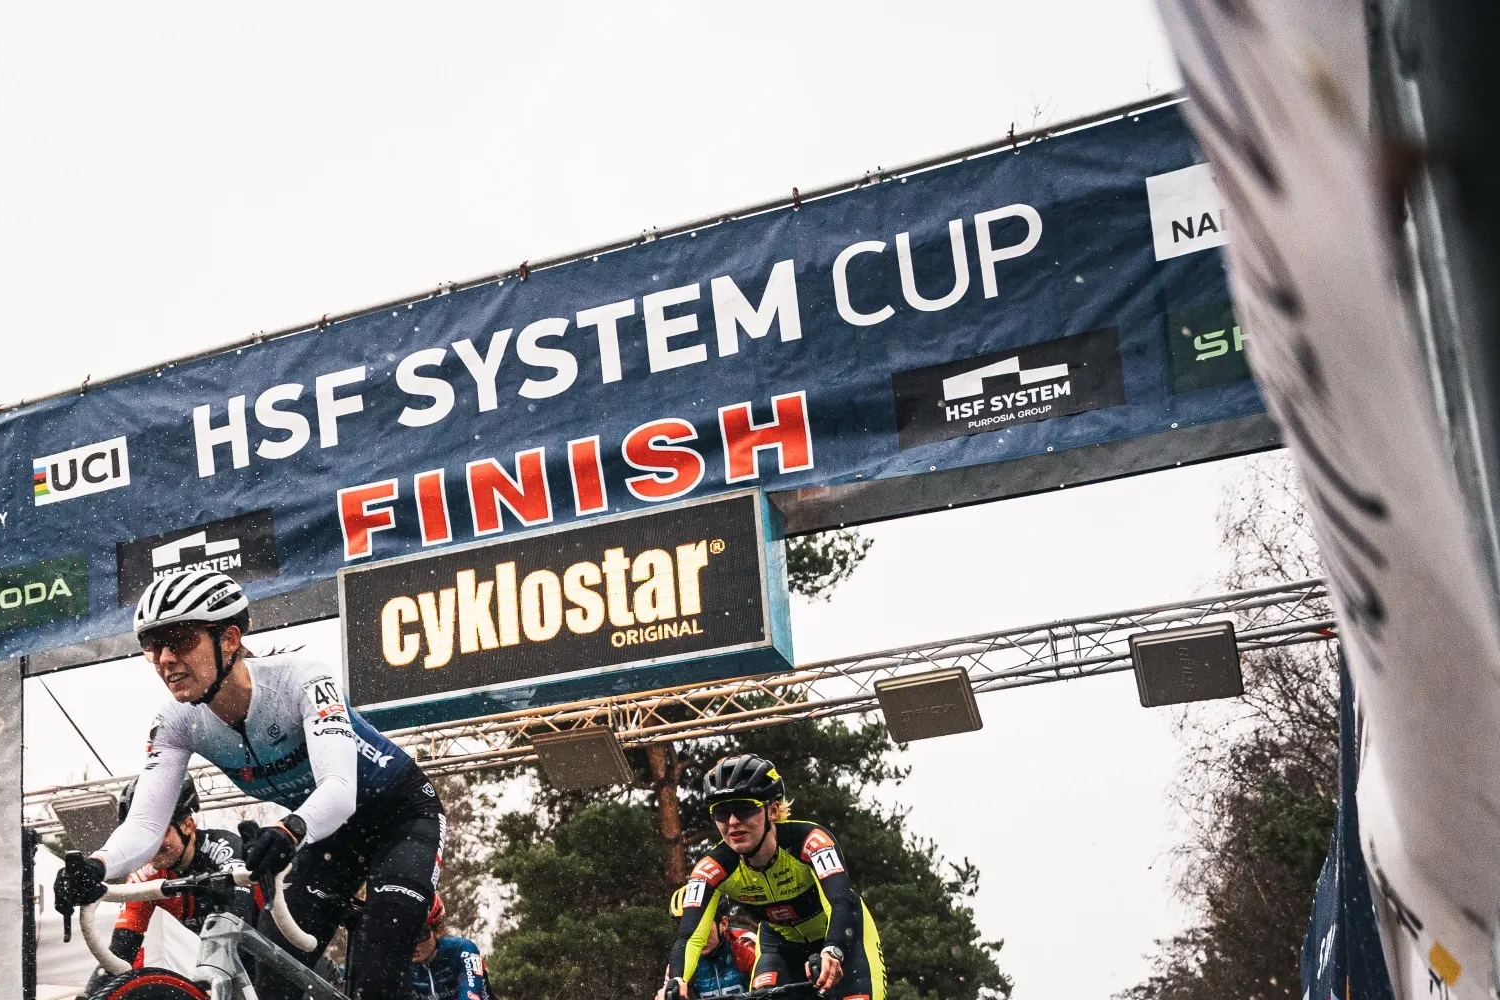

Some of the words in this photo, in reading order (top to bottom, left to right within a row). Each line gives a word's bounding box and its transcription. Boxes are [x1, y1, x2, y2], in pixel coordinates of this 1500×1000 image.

[192, 365, 368, 479] HSF
[395, 259, 802, 428] SYSTEM
[832, 203, 1043, 327] CUP
[944, 398, 985, 422] HSF
[989, 379, 1071, 413] SYSTEM
[967, 411, 1015, 429] PURPOSIA
[1017, 404, 1052, 422] GROUP
[50, 447, 121, 492] UCI
[337, 390, 815, 561] FINISH
[380, 539, 708, 670] cyklostar
[611, 619, 703, 648] ORIGINAL
[314, 681, 340, 705] 40
[357, 740, 394, 768] EK
[816, 851, 837, 872] 11
[374, 884, 426, 902] VERGE
